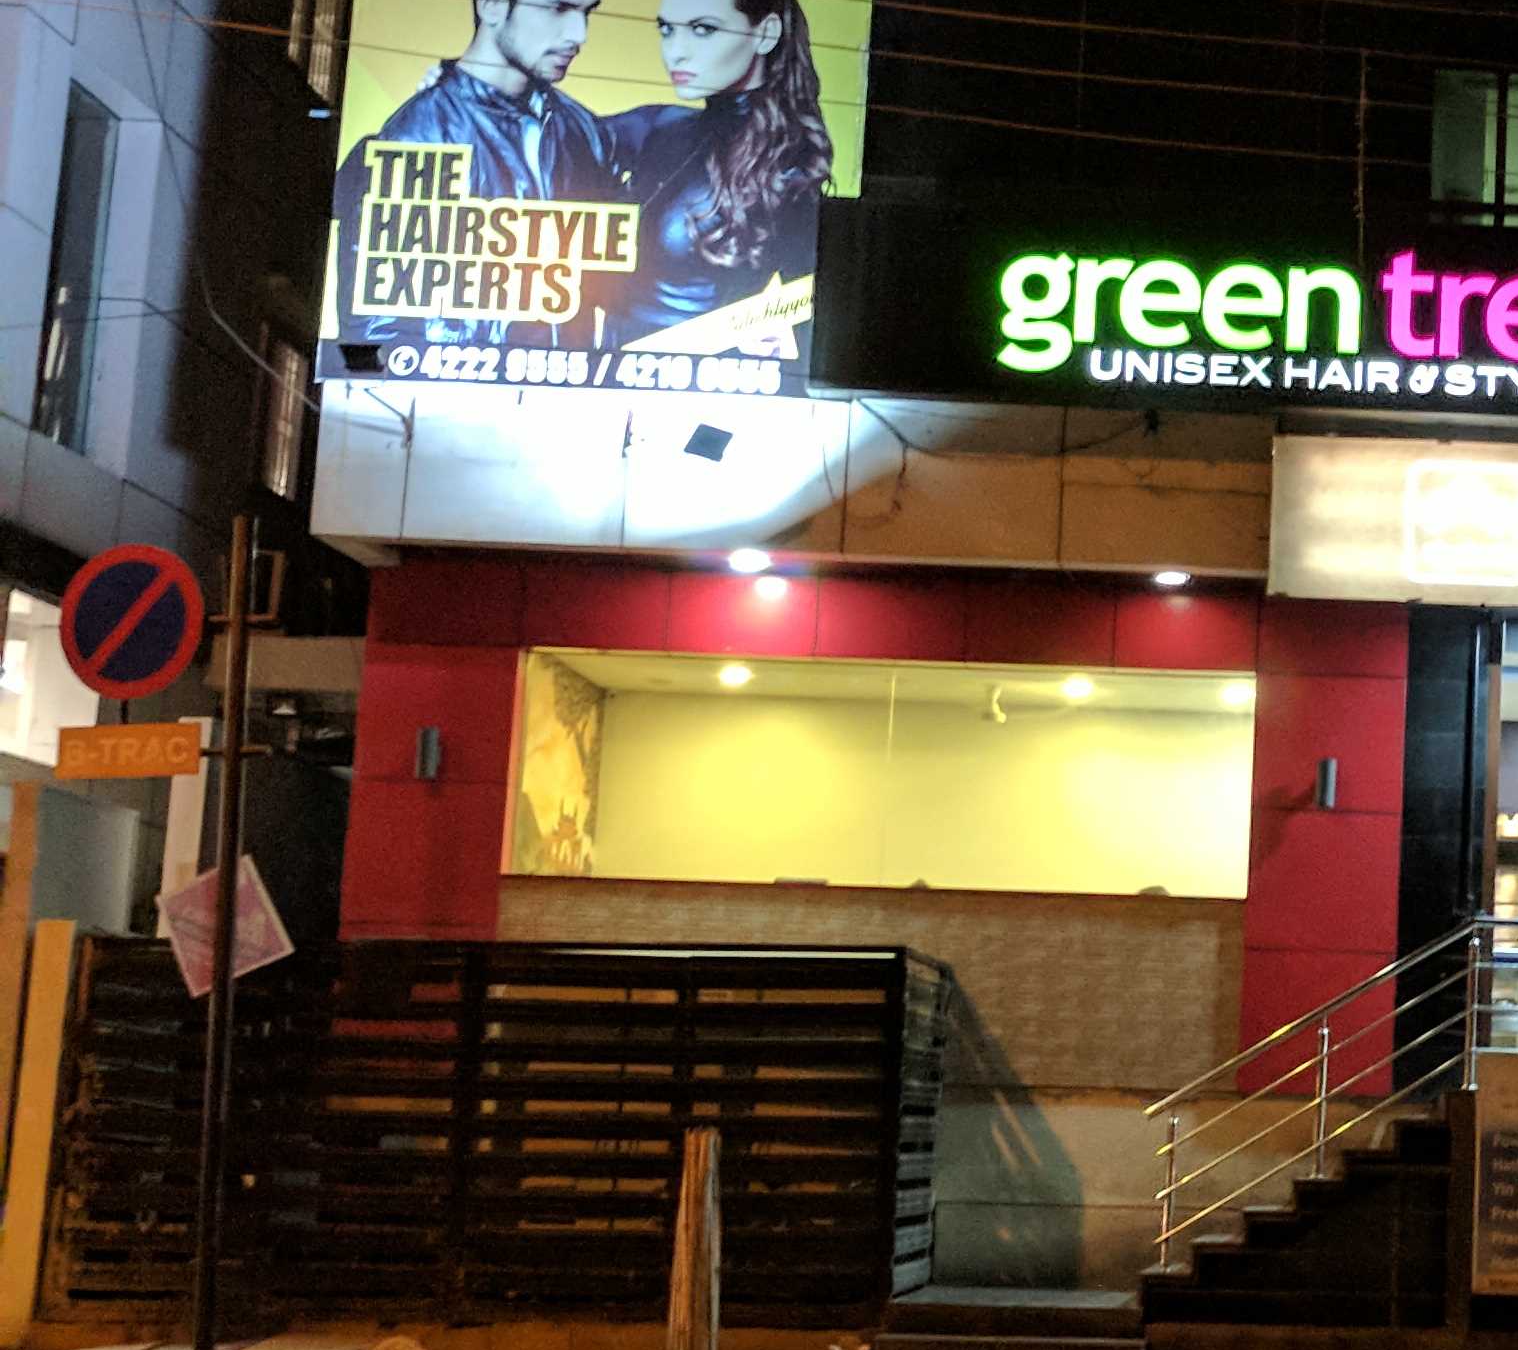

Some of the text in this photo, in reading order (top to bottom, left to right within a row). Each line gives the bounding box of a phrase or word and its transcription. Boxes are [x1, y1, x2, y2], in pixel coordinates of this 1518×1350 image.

[373, 149, 464, 200] THE
[367, 203, 631, 262] HAIRSTYLE
[362, 256, 572, 315] EXPERTS
[994, 251, 1361, 372] green
[1090, 347, 1272, 387] UNISEX
[1283, 355, 1399, 393] HAIR
[65, 736, 189, 766] B-TRAC
